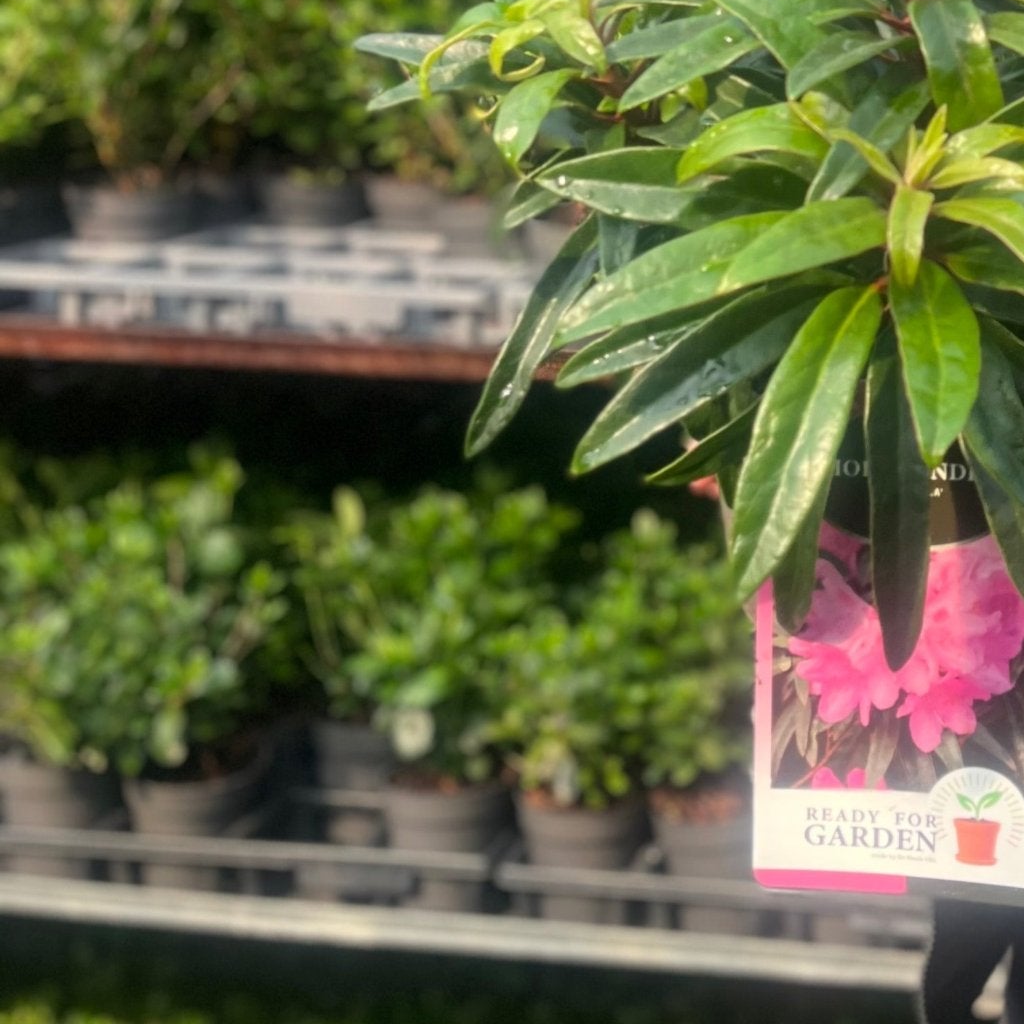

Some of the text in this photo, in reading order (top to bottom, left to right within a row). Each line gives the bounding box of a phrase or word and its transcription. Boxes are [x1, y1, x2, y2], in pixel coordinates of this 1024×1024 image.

[806, 807, 937, 828] READY FOR
[804, 823, 937, 853] GARDEN
